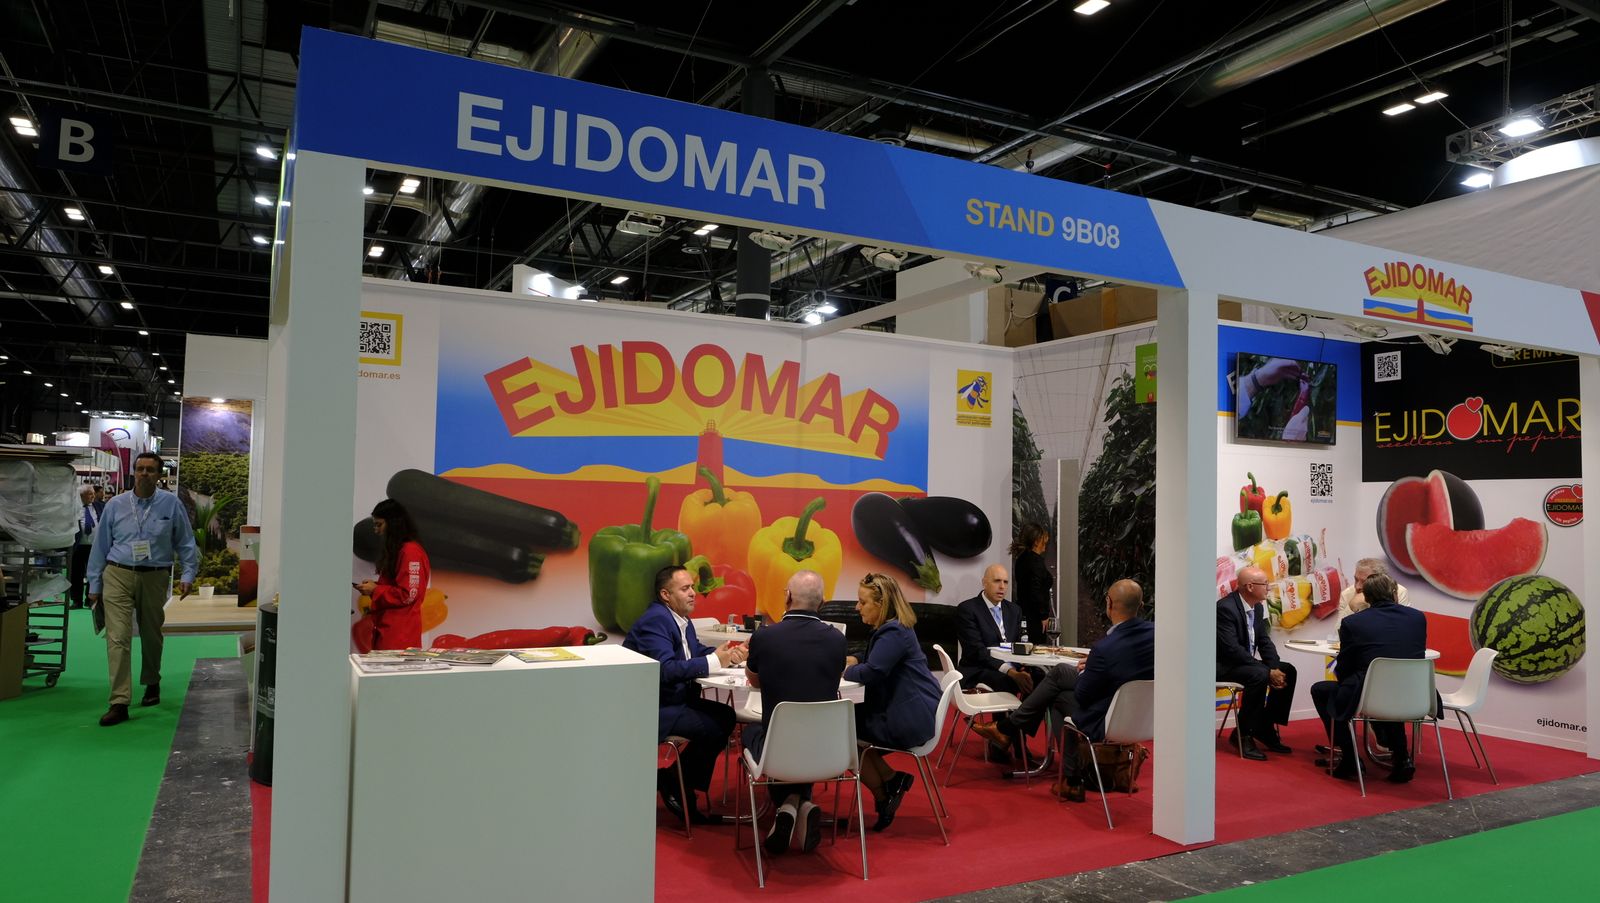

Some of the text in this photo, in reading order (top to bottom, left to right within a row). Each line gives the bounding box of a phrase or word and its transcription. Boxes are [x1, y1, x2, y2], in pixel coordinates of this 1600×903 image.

[58, 118, 95, 162] B
[457, 91, 826, 210] EJIDOMAR
[966, 198, 1120, 249] STAND 9B08
[1363, 261, 1472, 314] EJIDOMAR
[357, 370, 401, 380] domar.es
[483, 341, 900, 460] EJIDOMAR
[1536, 718, 1588, 732] ejidomar.e
